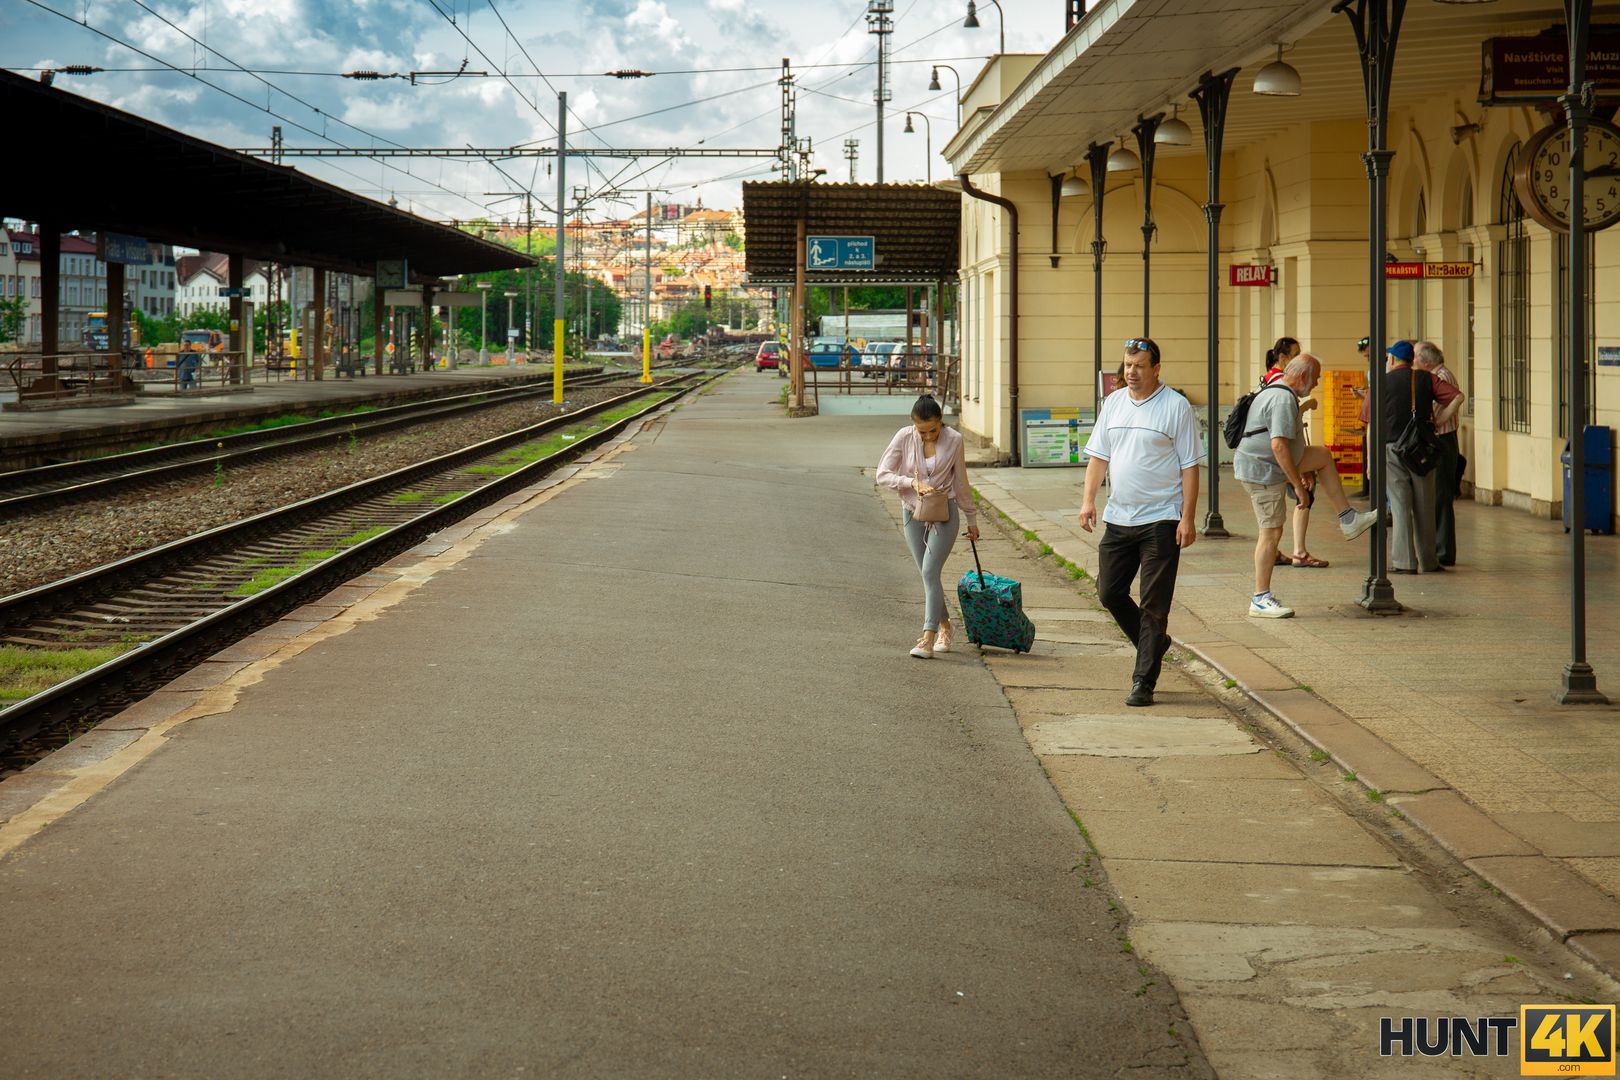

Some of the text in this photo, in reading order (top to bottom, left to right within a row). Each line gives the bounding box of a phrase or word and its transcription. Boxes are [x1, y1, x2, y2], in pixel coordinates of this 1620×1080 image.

[1504, 51, 1564, 63] Navštivte
[1598, 140, 1603, 153] 1
[1548, 152, 1560, 166] 10
[1608, 151, 1618, 166] 2
[1544, 169, 1554, 182] 9
[1549, 185, 1559, 199] 8
[1607, 186, 1617, 199] 4
[1562, 199, 1570, 211] 7
[1596, 198, 1606, 211] 5
[1236, 266, 1267, 283] RELAY
